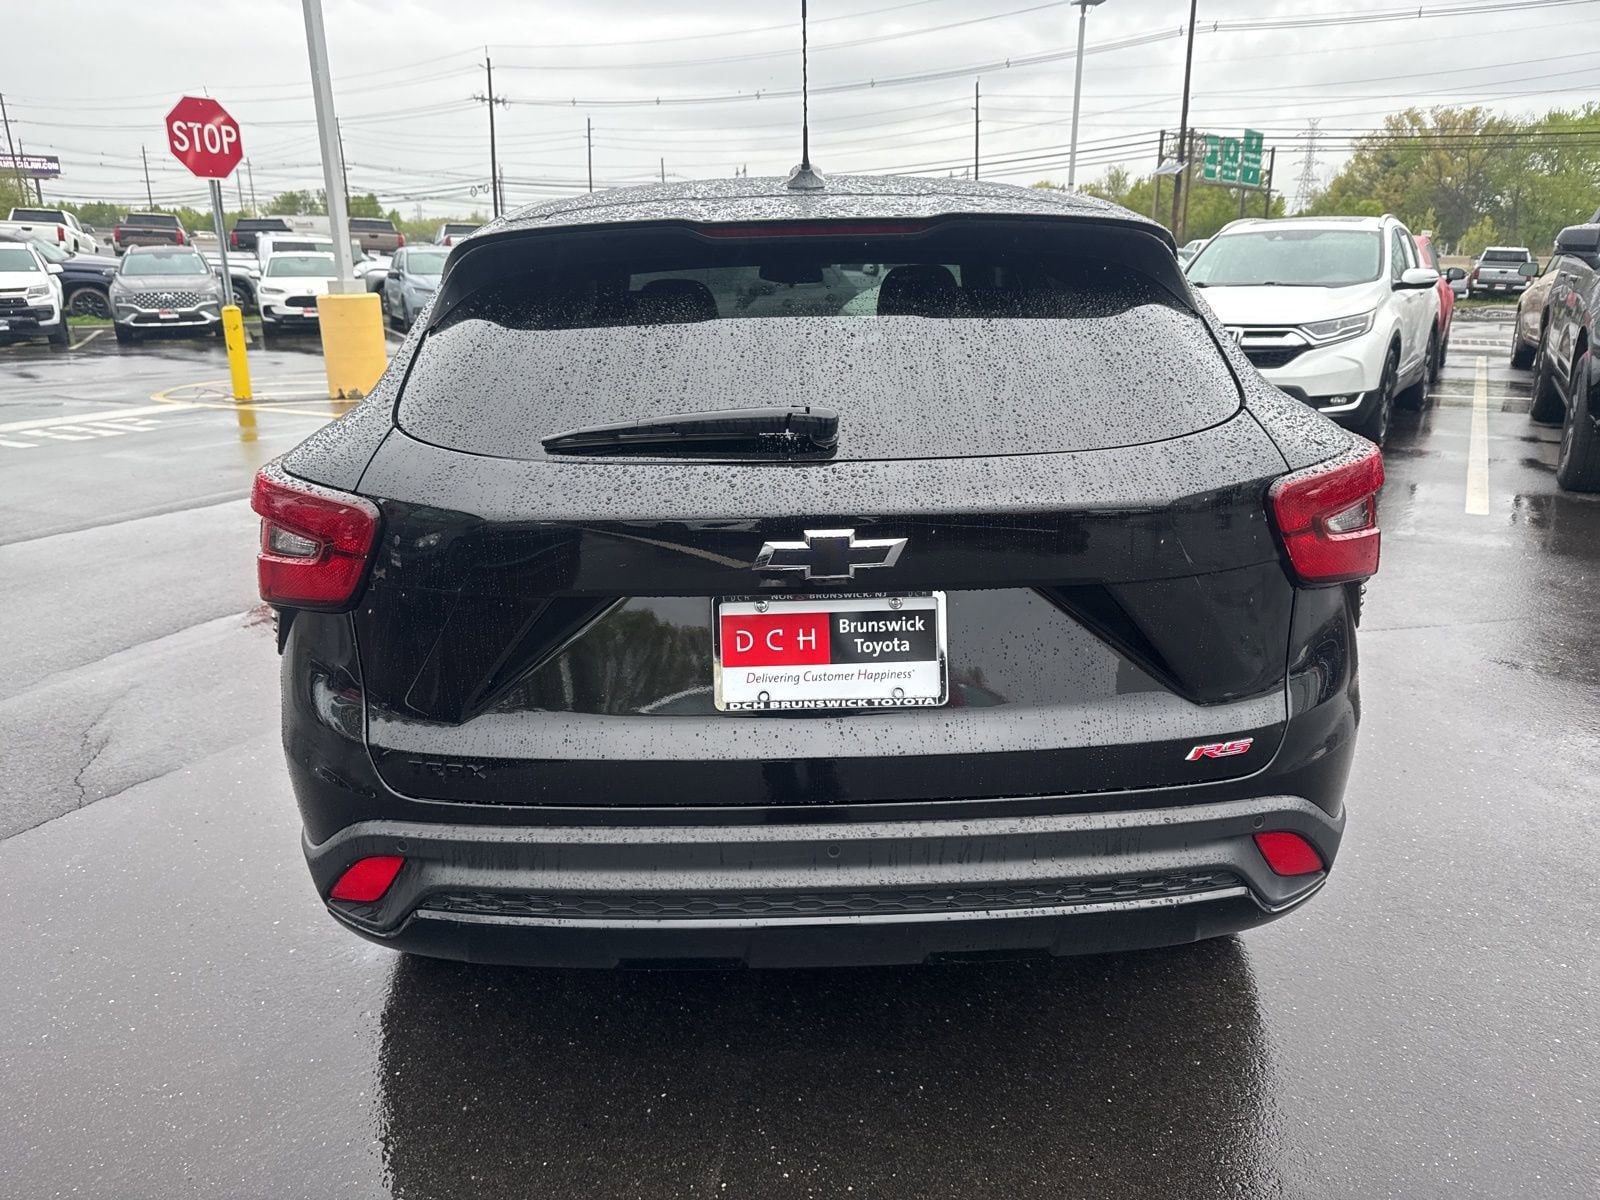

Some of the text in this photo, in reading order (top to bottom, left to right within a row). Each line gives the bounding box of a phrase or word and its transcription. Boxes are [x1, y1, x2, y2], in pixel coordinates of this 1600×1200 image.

[172, 120, 238, 154] STOP
[839, 616, 925, 634] Brunswick
[854, 638, 910, 658] Toyota
[746, 671, 800, 685] Delivering
[803, 670, 854, 682] Customer
[730, 696, 935, 710] DCH BRUNSWICK TOYOTA
[1184, 738, 1254, 760] RS
